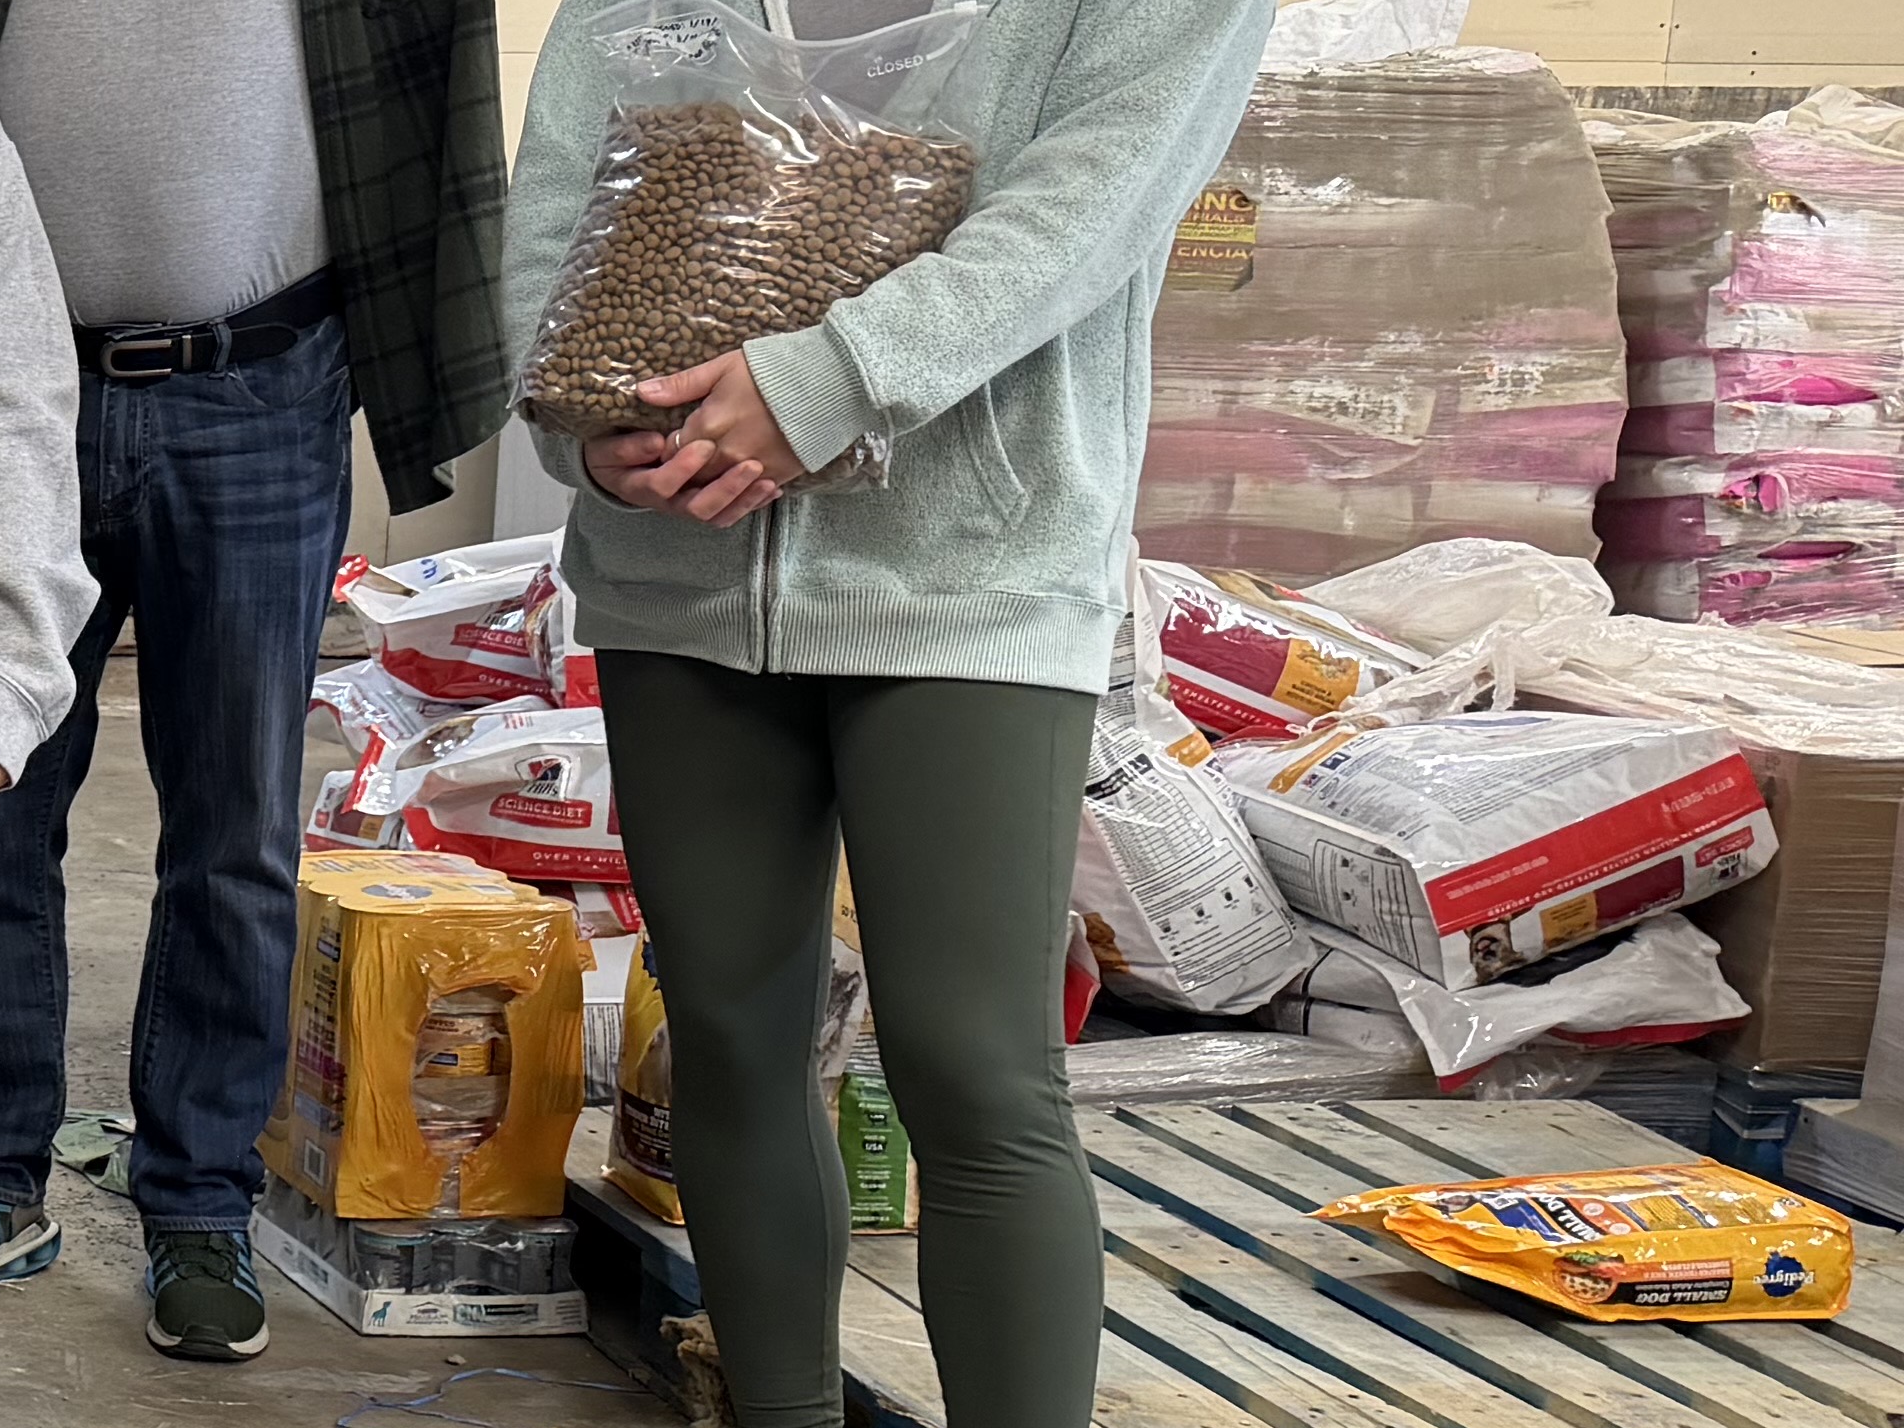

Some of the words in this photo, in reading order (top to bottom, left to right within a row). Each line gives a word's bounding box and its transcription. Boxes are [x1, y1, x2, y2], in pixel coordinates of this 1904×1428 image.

[866, 55, 924, 78] CLOSED
[497, 797, 550, 814] SCIENCE
[552, 801, 586, 818] DIET
[532, 852, 570, 861] OVER
[1753, 1270, 1815, 1285] Pedigree
[1636, 1292, 1671, 1303] DOG
[1674, 1290, 1728, 1303] SMALL
